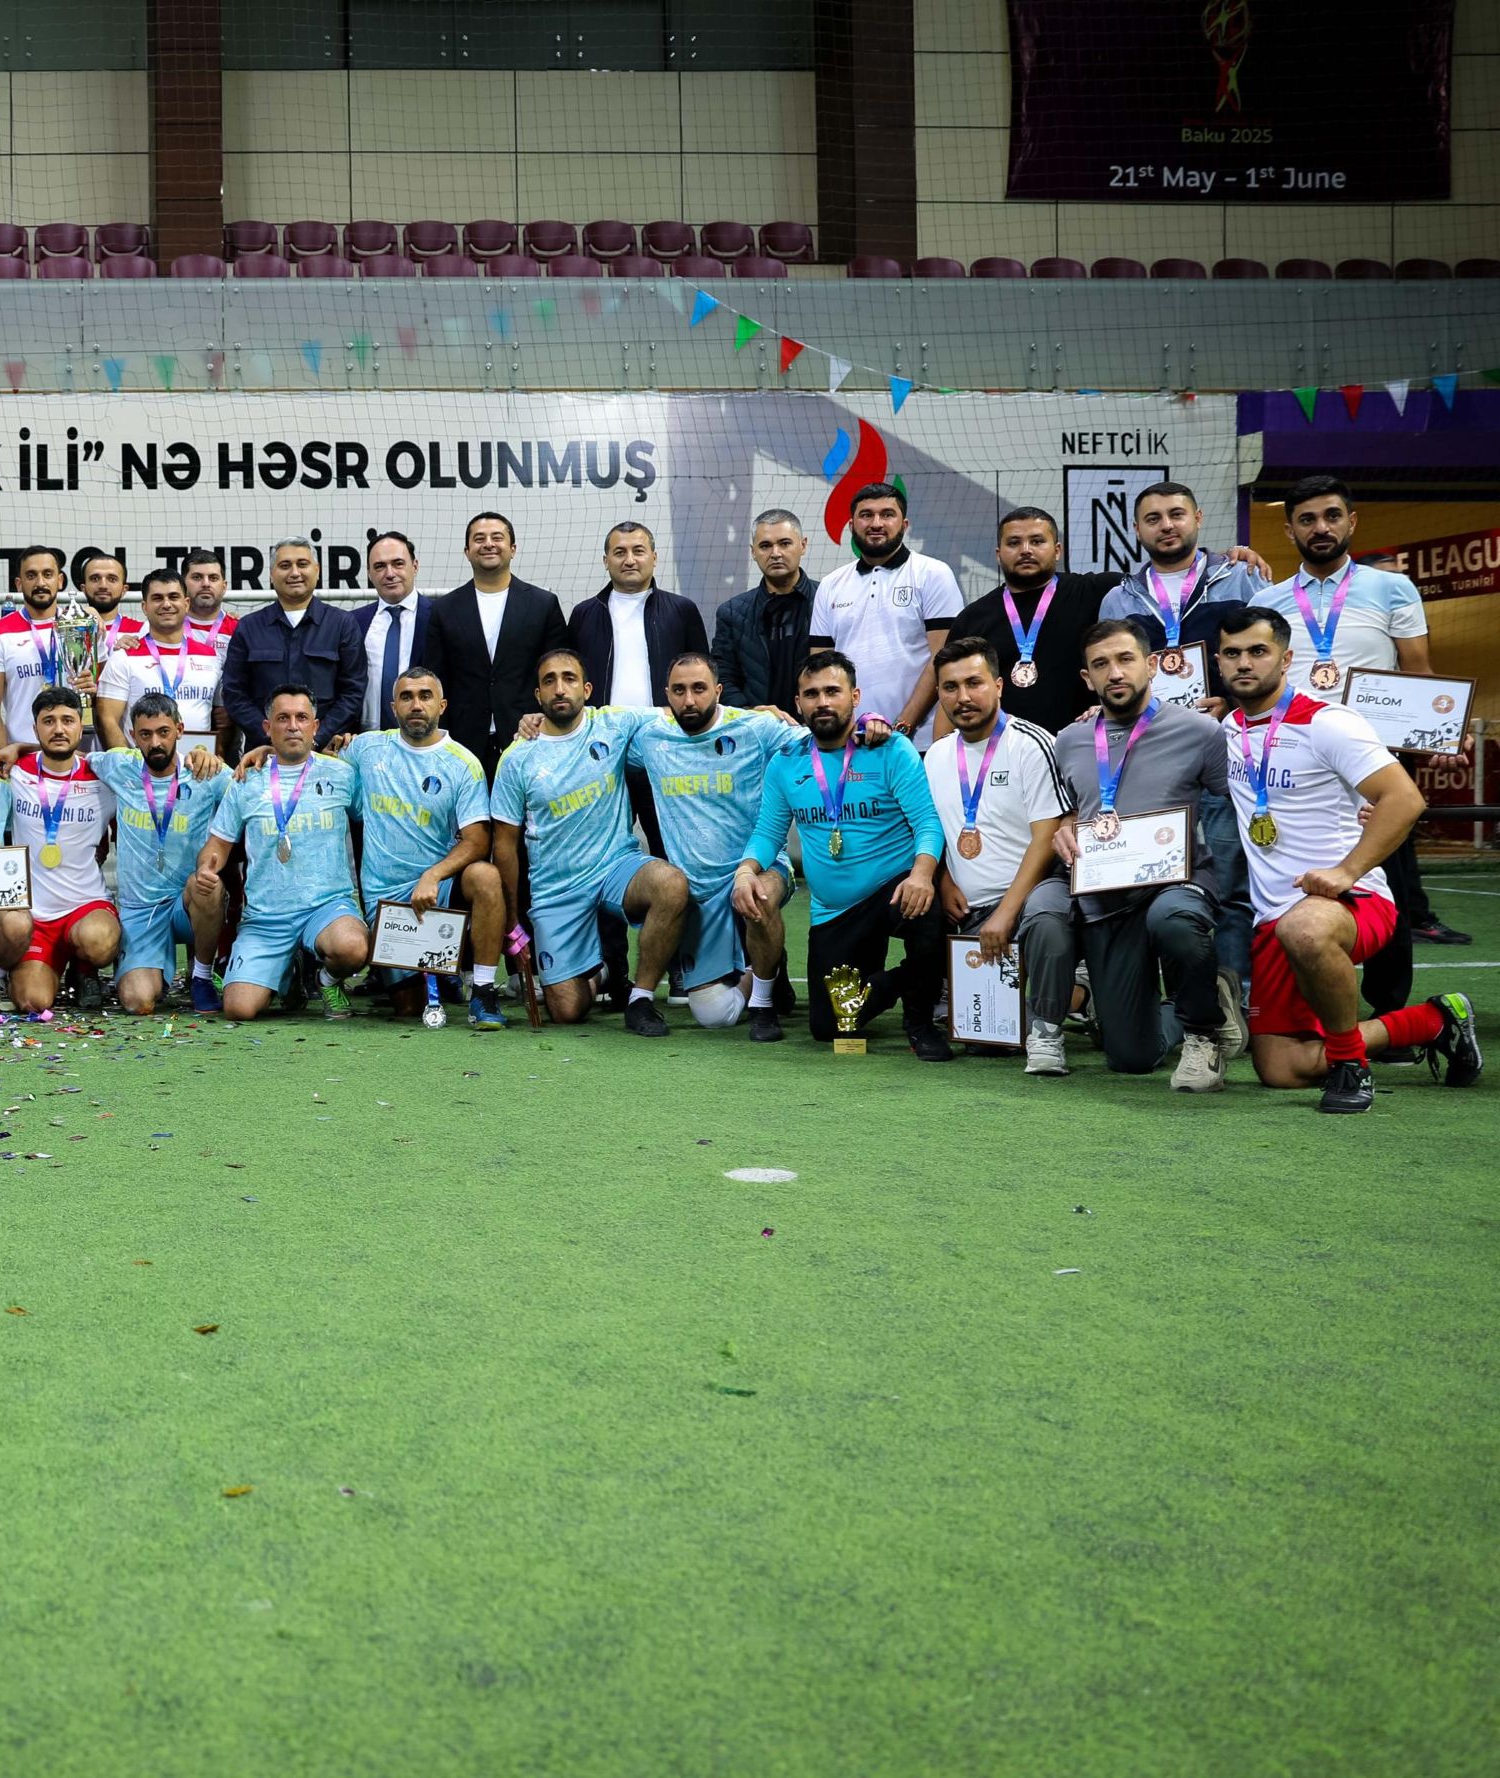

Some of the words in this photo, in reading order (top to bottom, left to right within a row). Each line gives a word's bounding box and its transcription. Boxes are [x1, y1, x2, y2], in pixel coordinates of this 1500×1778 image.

[1181, 127, 1225, 143] Baku
[1230, 128, 1274, 143] 2025
[1109, 164, 1154, 187] 21st
[1162, 166, 1216, 193] May
[1246, 166, 1276, 188] 1st
[1282, 167, 1347, 189] June
[1062, 428, 1141, 458] NEFTÇİ
[1148, 428, 1169, 455] İK
[121, 440, 201, 490] NƏ
[218, 440, 371, 490] HƏSR
[385, 440, 657, 503] OLUNMUŞ
[1356, 693, 1403, 707] DİPLOM
[1084, 840, 1127, 854] DİPLOM
[383, 921, 418, 933] DİPLOM
[971, 993, 982, 1033] DİPLOM
